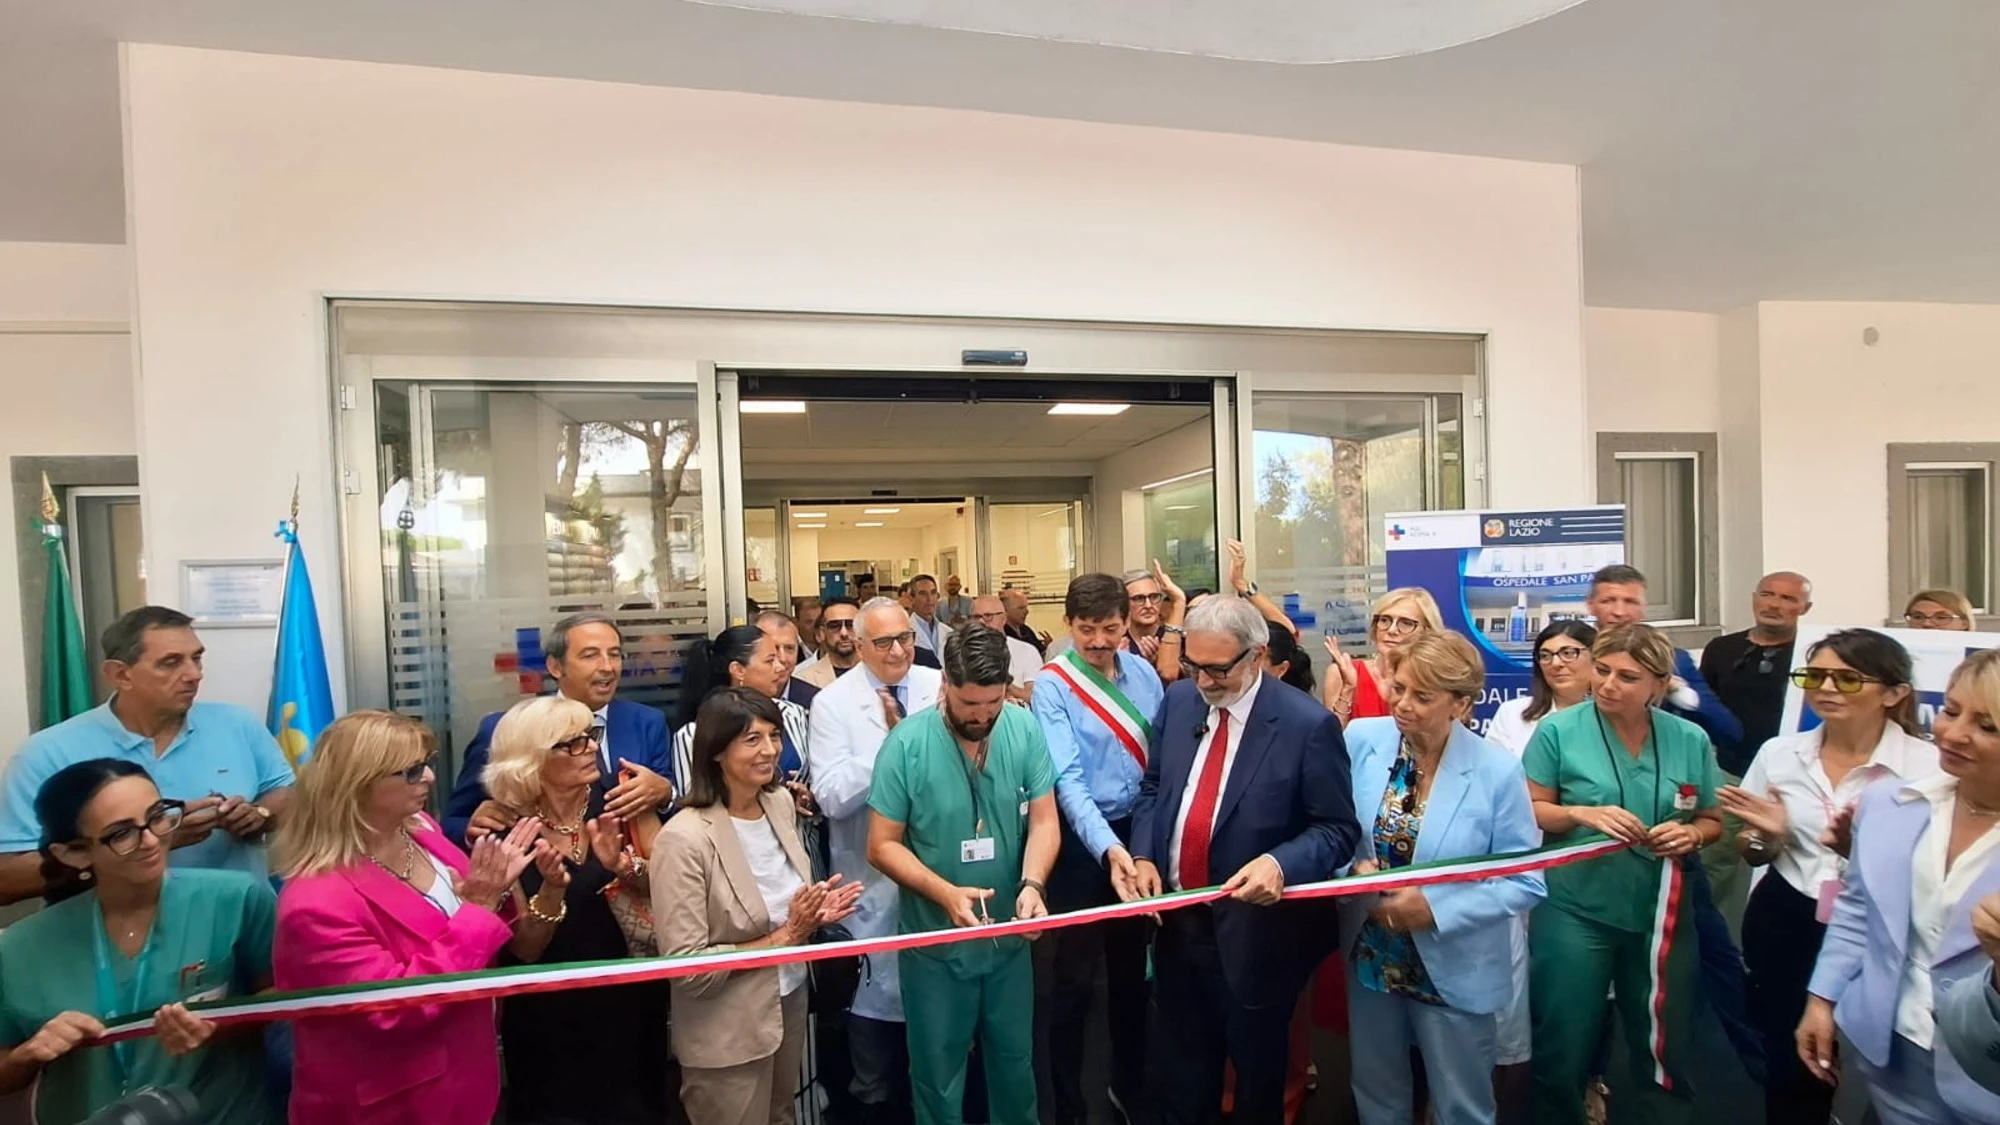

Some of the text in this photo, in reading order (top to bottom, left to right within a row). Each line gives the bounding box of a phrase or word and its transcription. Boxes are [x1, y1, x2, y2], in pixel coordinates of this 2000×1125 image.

[1509, 518, 1554, 528] REGIONE
[1510, 528, 1540, 537] LAZIO
[1493, 573, 1594, 587] OSPEDALE SAN PA
[1474, 687, 1528, 705] DALE
[1470, 718, 1491, 735] PA
